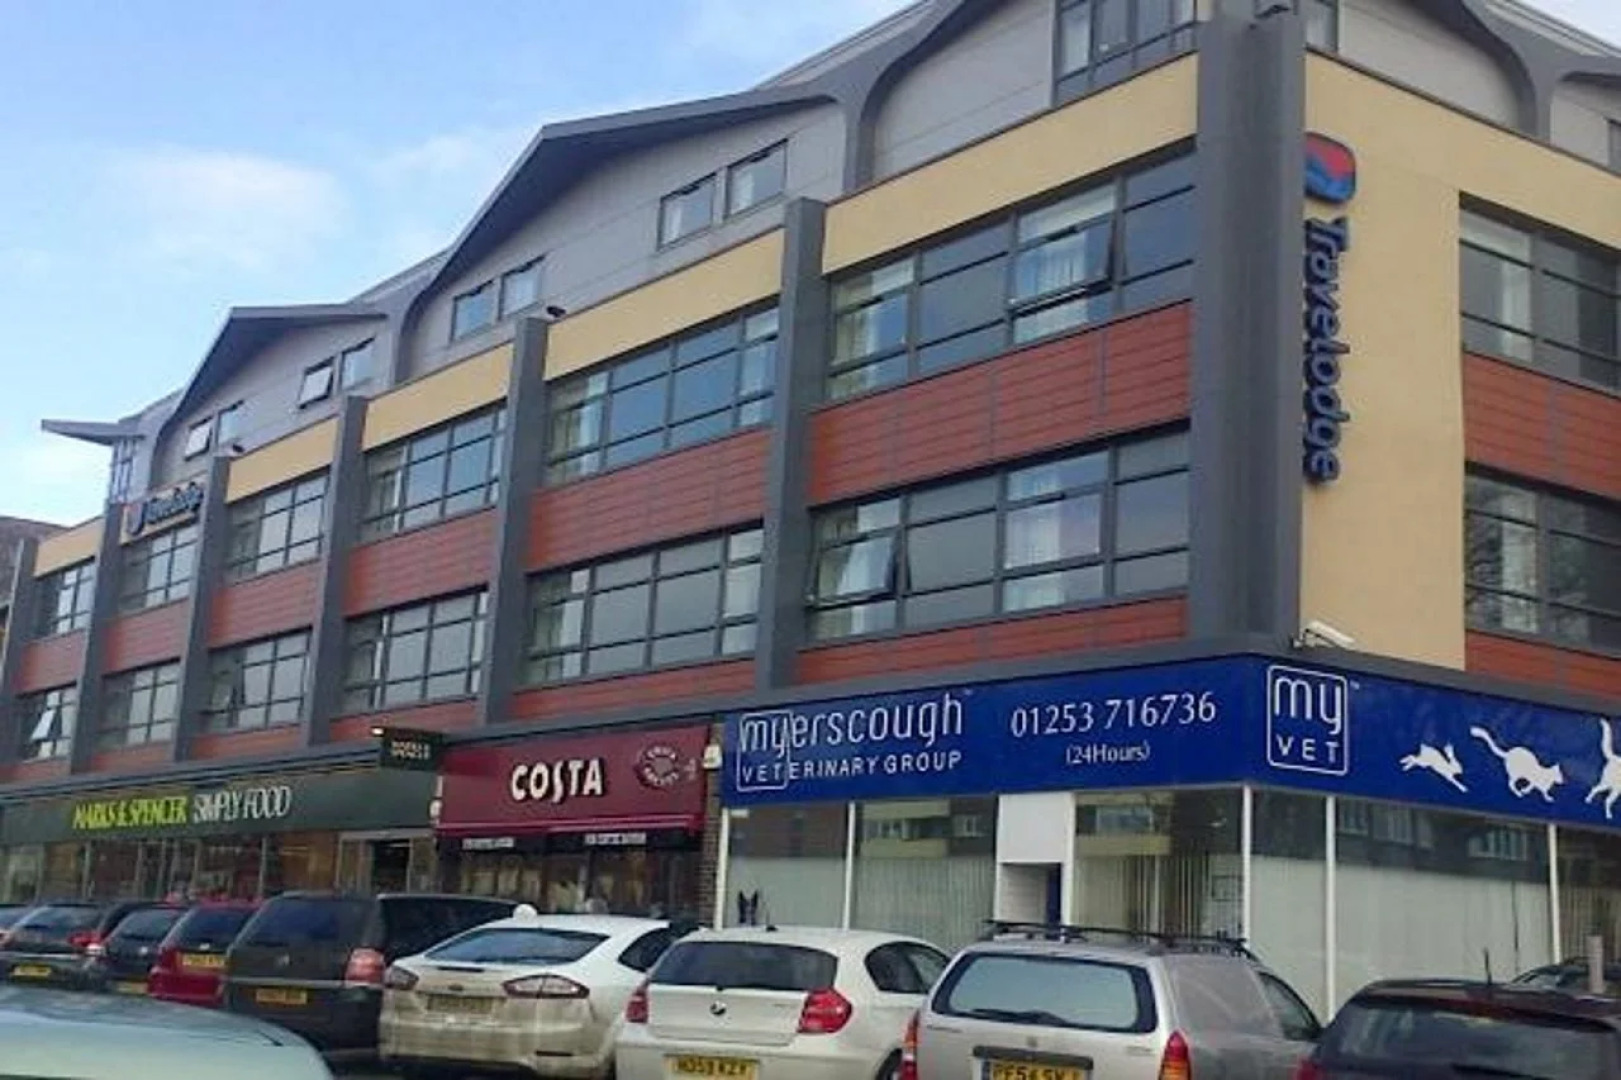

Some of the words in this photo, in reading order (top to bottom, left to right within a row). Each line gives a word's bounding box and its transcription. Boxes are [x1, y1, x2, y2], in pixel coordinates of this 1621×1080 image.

[1302, 216, 1350, 483] Travelodge
[741, 692, 963, 758] myerscough
[1011, 702, 1095, 738] 01253
[1103, 691, 1216, 730] 716736
[1273, 676, 1343, 735] my
[742, 754, 878, 783] VETERINARY
[883, 749, 962, 775] GROUP
[1066, 739, 1151, 765] (24Hours)
[1275, 734, 1340, 764] VET
[511, 757, 604, 801] COSTA
[243, 785, 292, 819] FOOD
